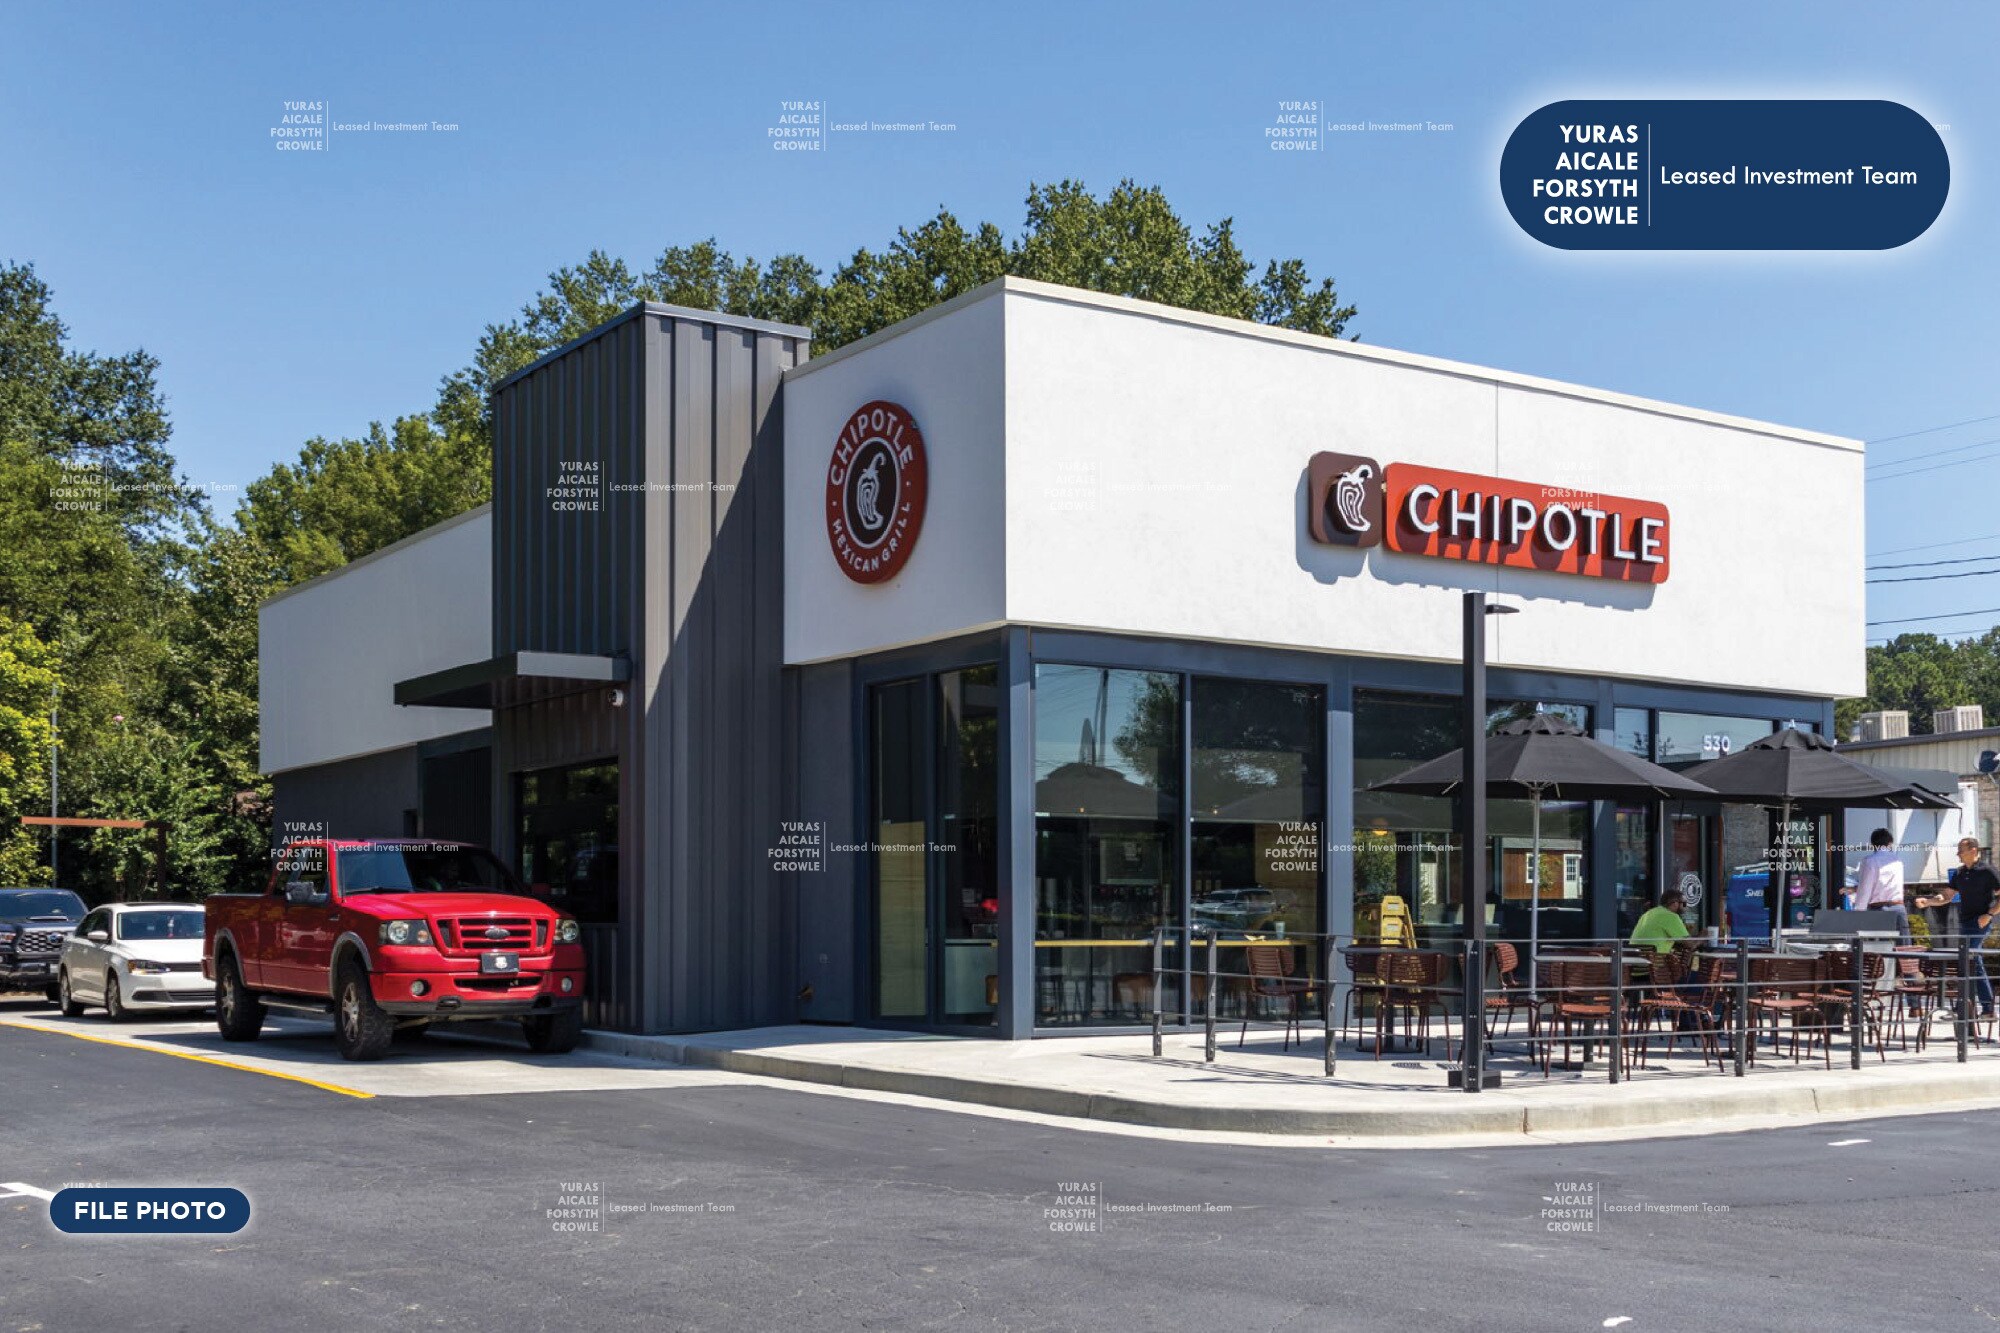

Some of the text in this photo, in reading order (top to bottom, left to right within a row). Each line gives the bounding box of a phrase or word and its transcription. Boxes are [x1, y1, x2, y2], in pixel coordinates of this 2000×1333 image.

[830, 408, 914, 486] CHIPOTLE
[832, 503, 911, 573] MEXICAN GRILL
[1408, 483, 1665, 563] CHIPOTLE
[1703, 734, 1730, 752] 530
